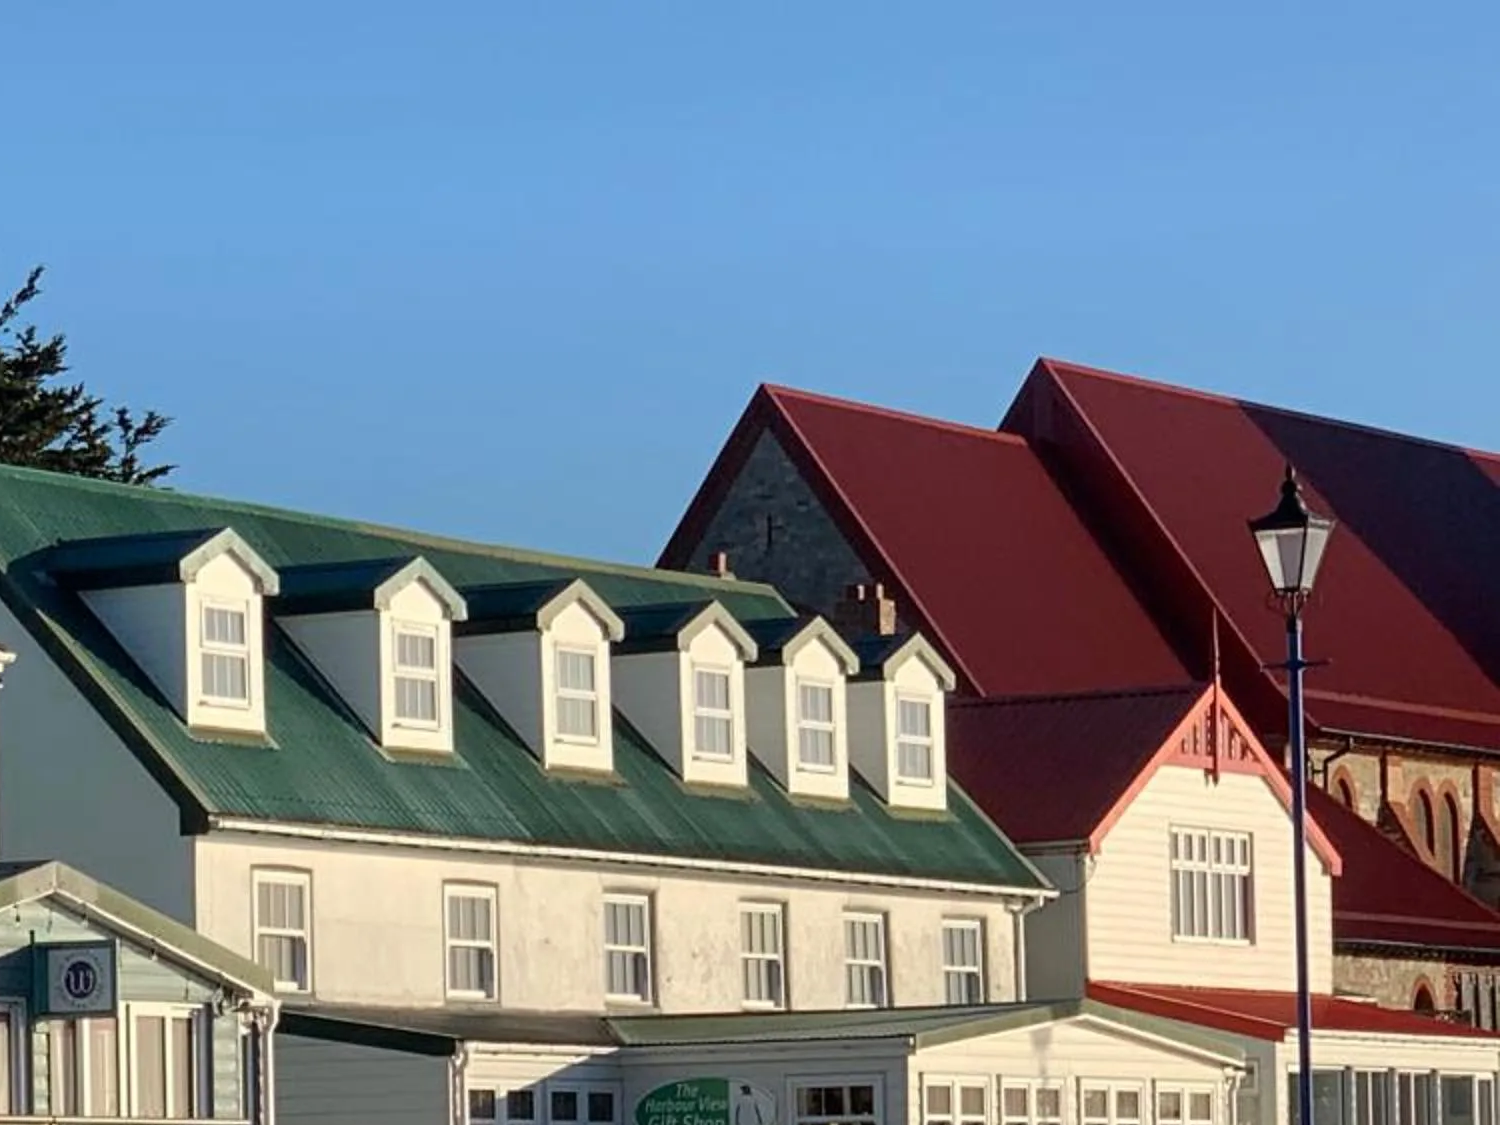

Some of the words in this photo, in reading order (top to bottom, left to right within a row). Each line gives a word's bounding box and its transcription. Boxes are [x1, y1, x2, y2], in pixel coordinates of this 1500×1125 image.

[676, 1083, 699, 1098] The
[645, 1097, 697, 1113] Harbour
[698, 1095, 728, 1112] View
